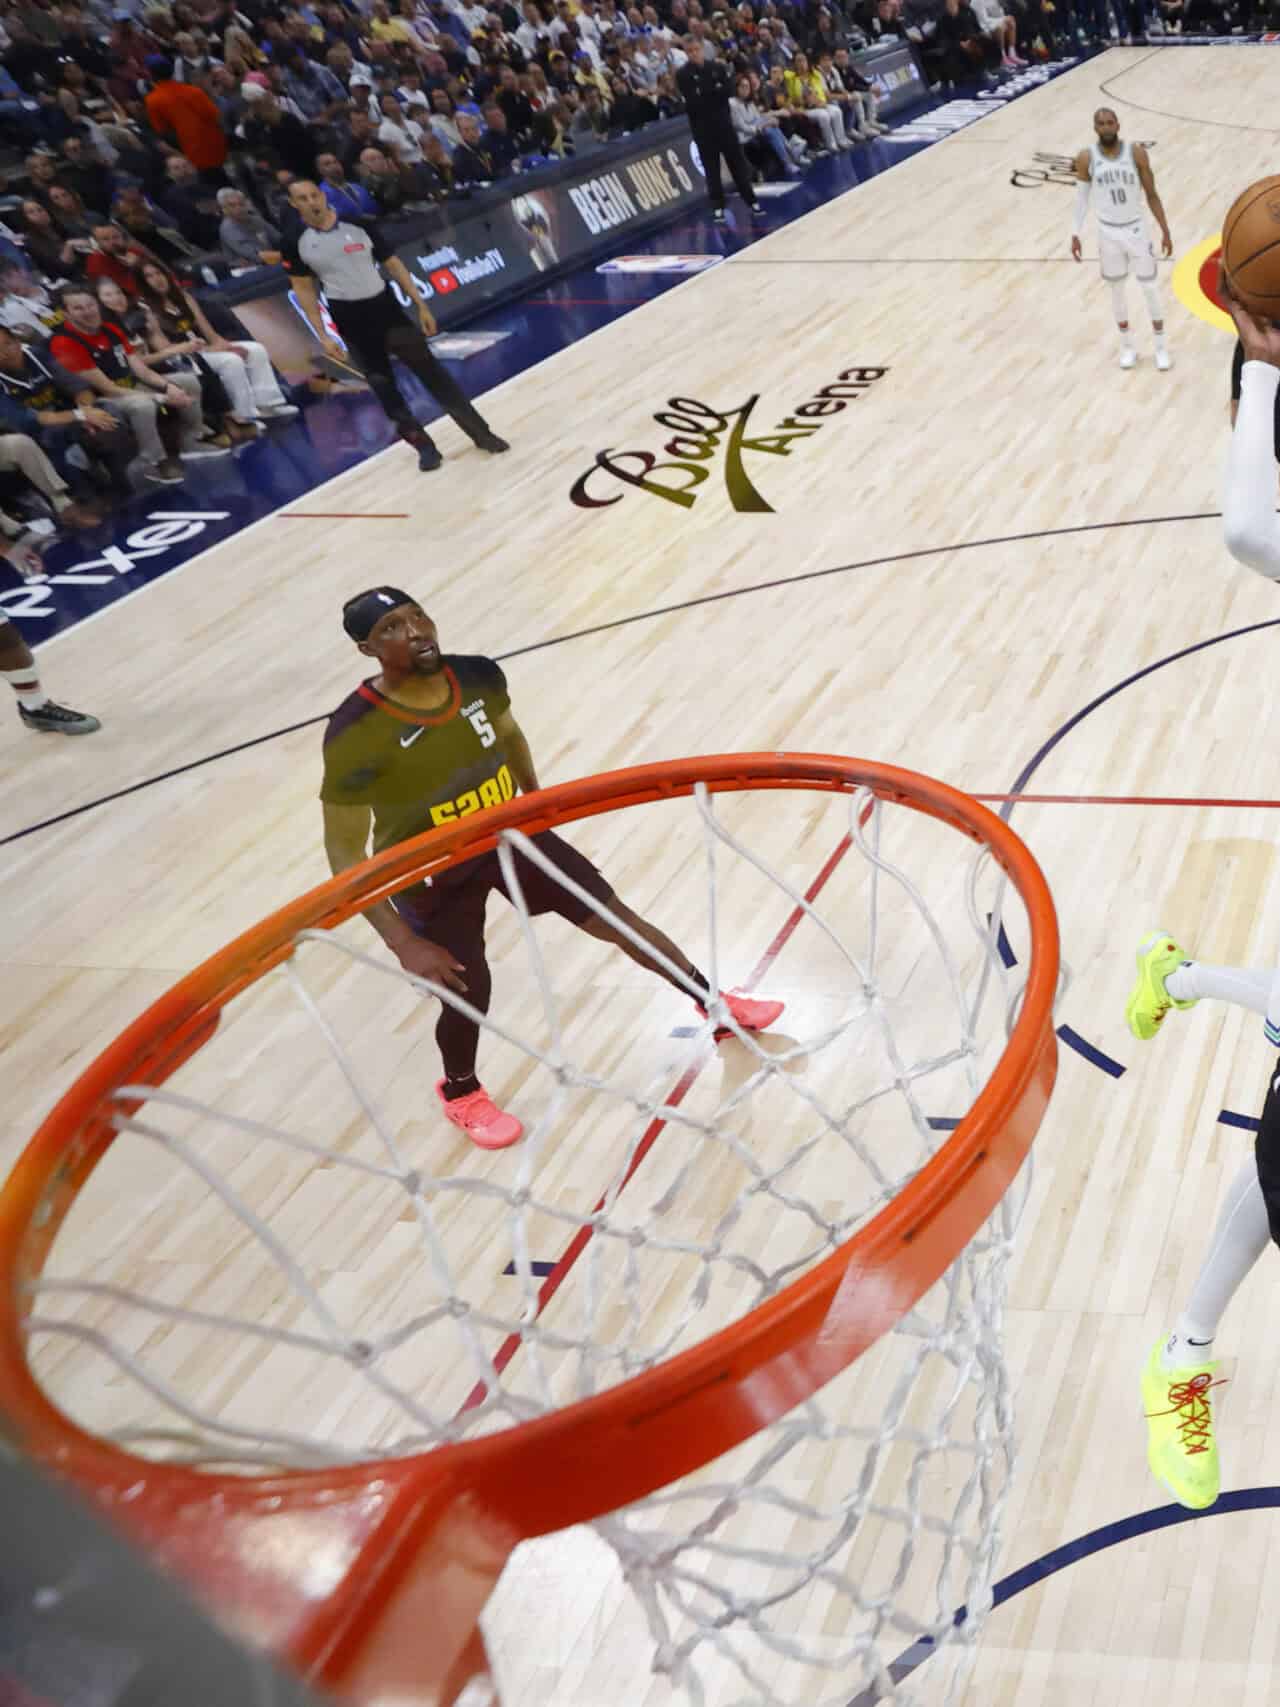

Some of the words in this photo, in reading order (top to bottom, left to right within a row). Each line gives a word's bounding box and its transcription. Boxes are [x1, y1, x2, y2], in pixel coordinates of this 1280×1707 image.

[568, 171, 639, 234] BEGIN
[625, 154, 681, 211] JUNE
[666, 148, 693, 192] 6
[1110, 188, 1128, 206] 10
[569, 394, 777, 513] Ball
[740, 366, 891, 457] Arena
[468, 709, 496, 749] 5
